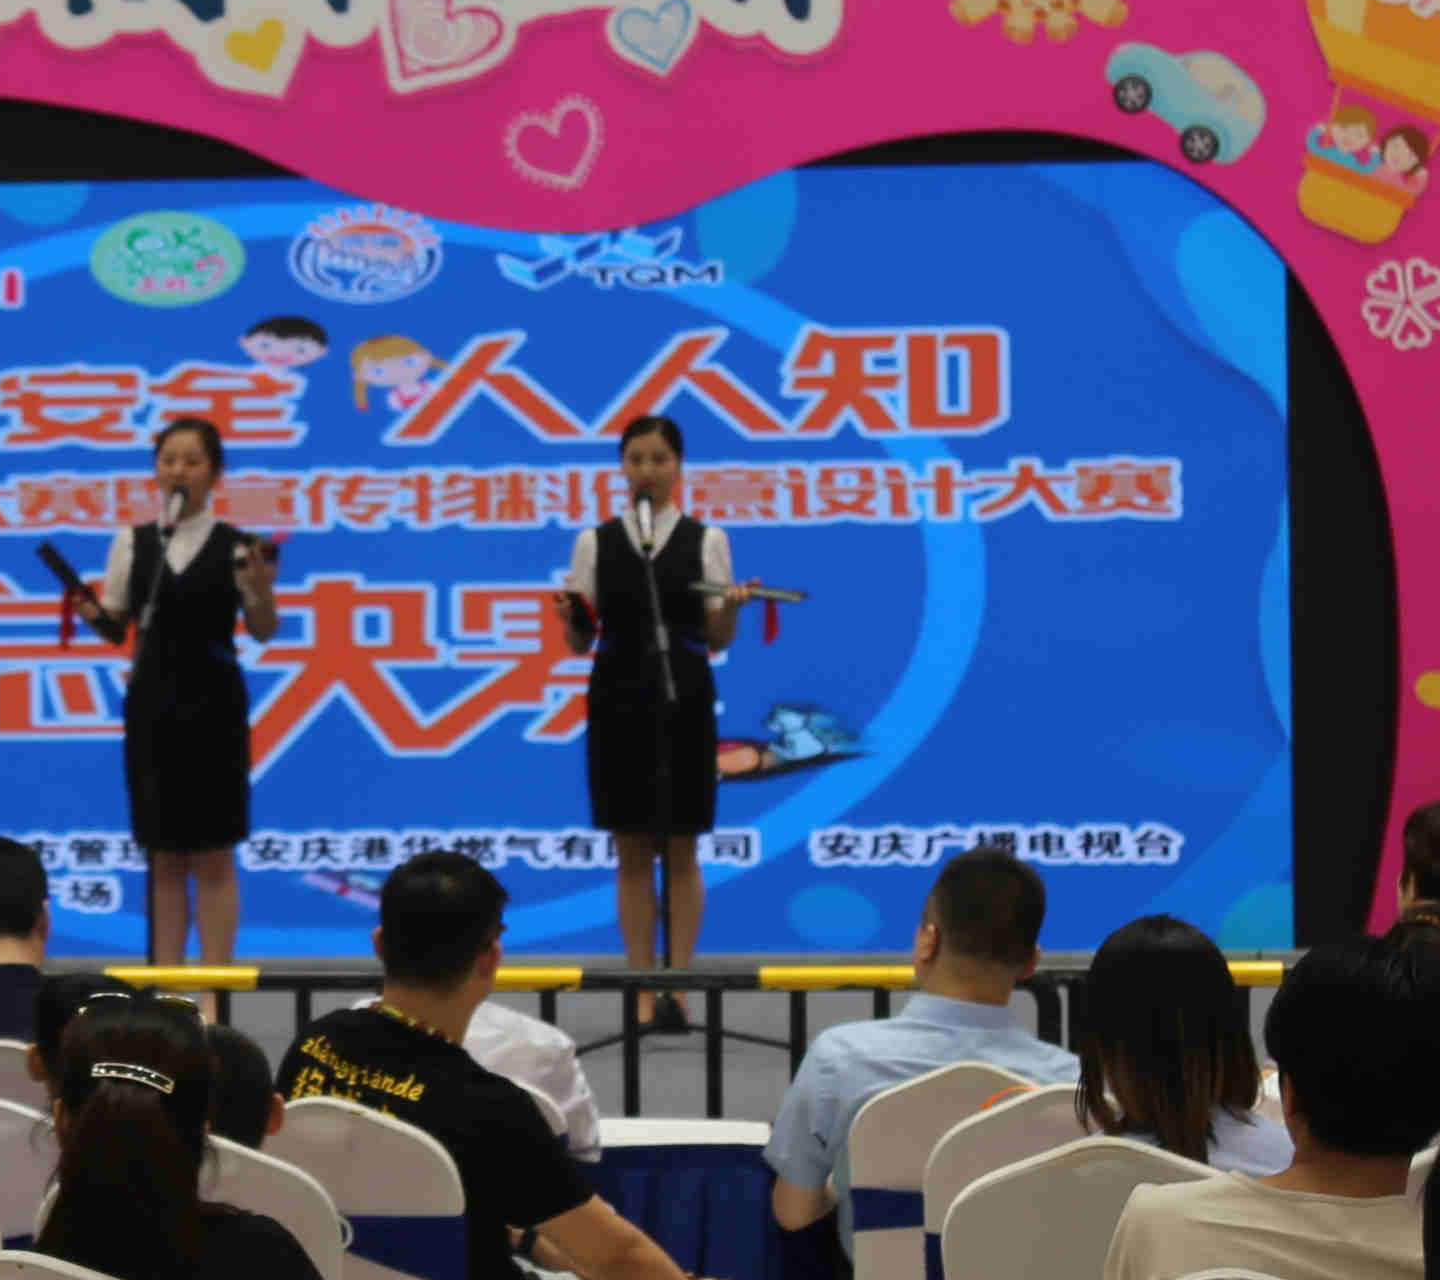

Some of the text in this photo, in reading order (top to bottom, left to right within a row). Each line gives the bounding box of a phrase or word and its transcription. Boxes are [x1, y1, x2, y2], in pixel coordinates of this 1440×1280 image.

[390, 330, 1007, 440] 人人知
[246, 830, 757, 868] 安庆港华燃气有司
